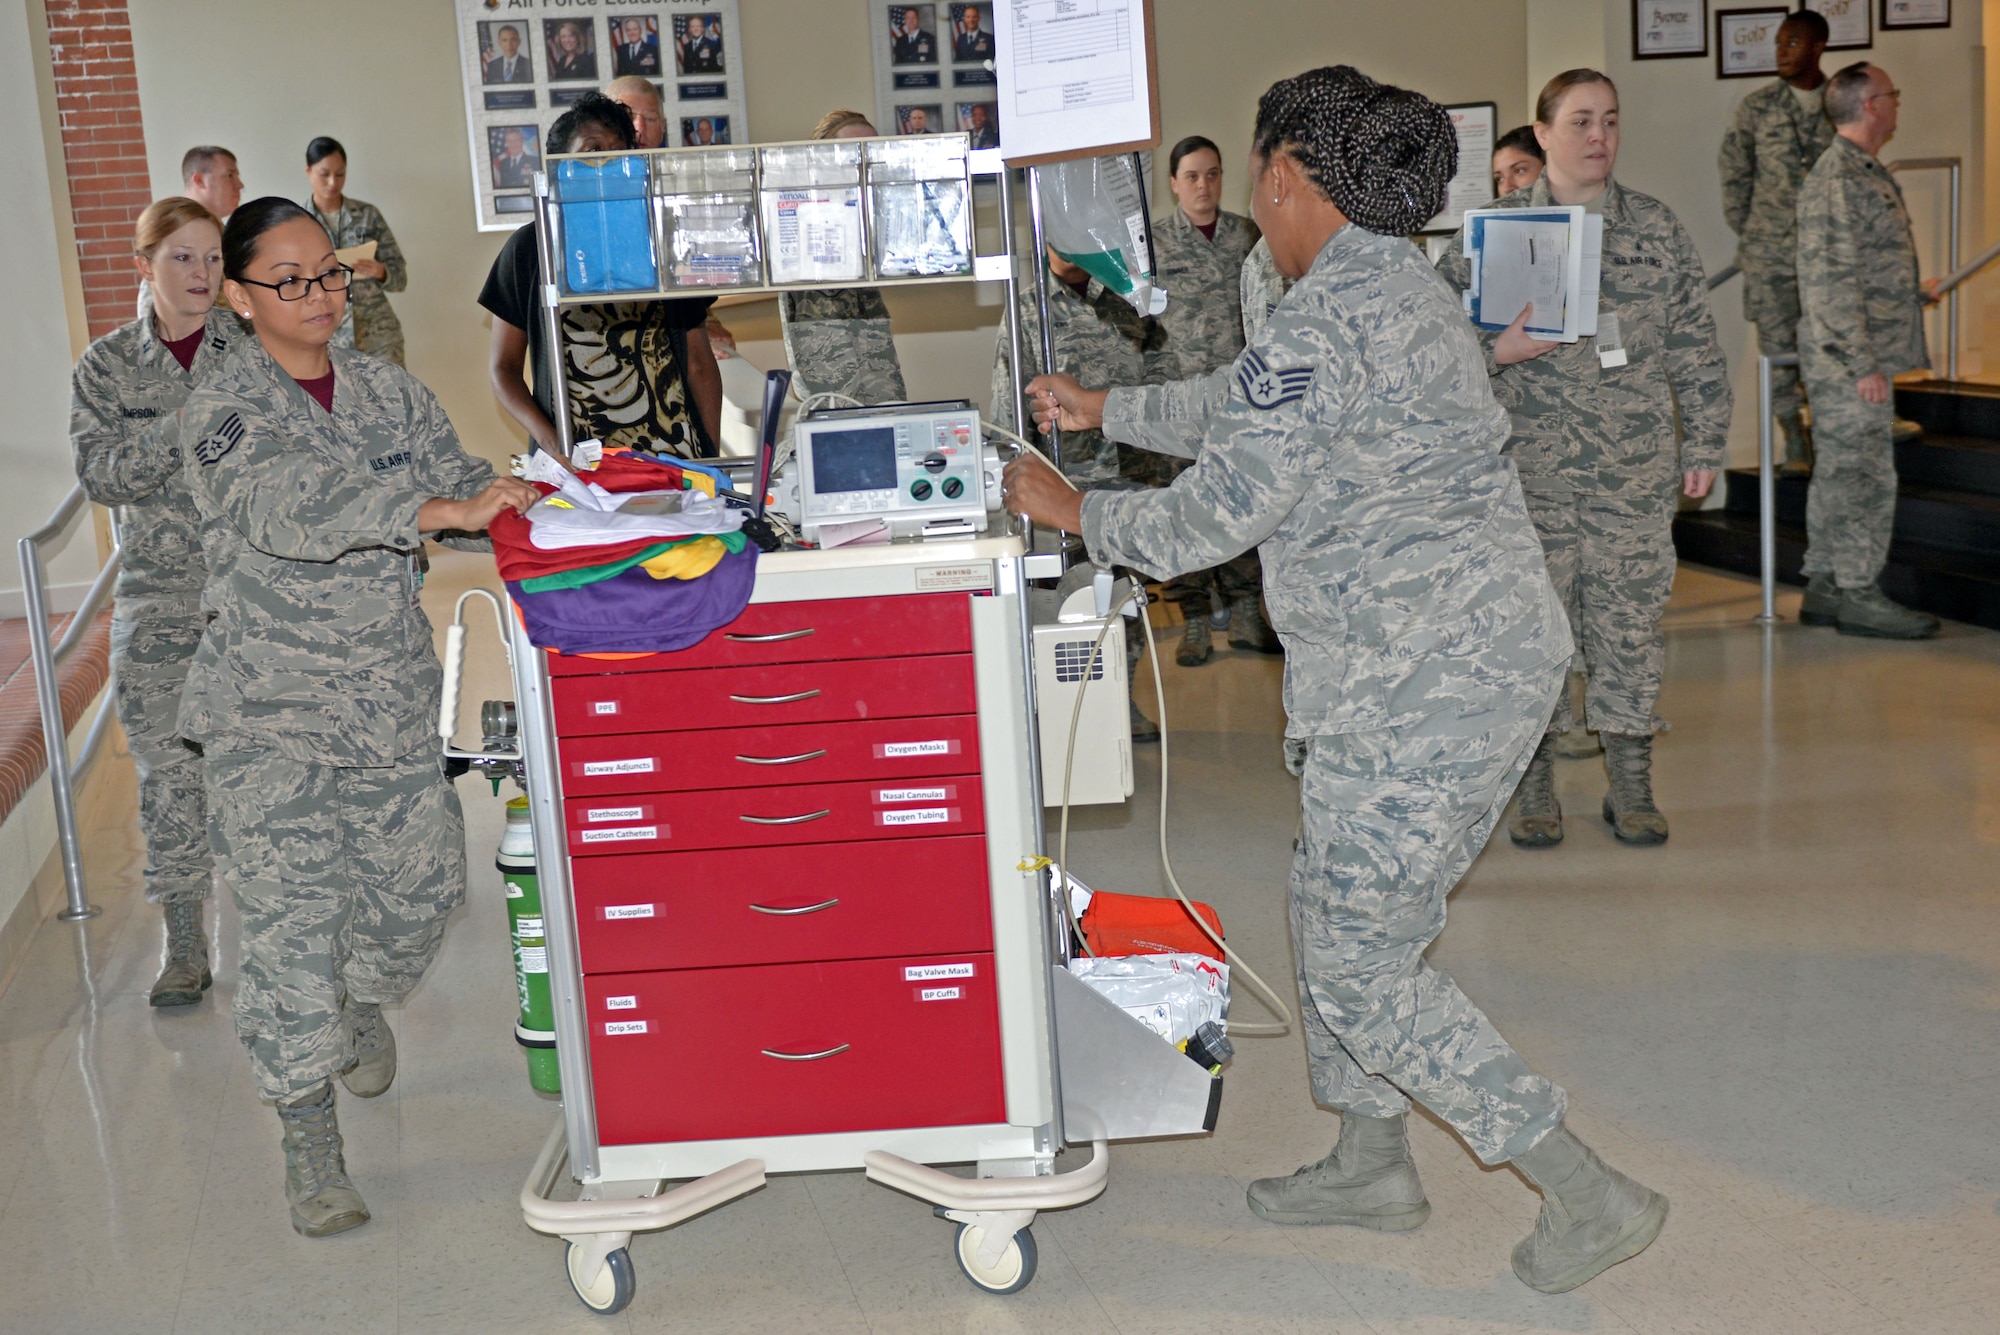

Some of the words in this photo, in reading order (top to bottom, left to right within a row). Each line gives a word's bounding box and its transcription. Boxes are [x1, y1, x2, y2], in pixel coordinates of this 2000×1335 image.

[1733, 23, 1774, 46] Gold
[369, 458, 389, 471] U.S.
[387, 453, 405, 468] AIR
[935, 568, 972, 576] WARNING
[598, 704, 614, 712] PPE
[887, 745, 918, 754] Oxygen
[919, 743, 946, 752] Masks
[585, 765, 614, 774] Airway
[615, 762, 651, 772] Adjuncts
[882, 792, 905, 800] Nasal
[906, 790, 944, 799] Cannulas
[589, 809, 639, 819] Stethoscope
[885, 814, 916, 823] Oxygen
[917, 811, 946, 820] Tubing
[584, 831, 614, 840] Suction
[615, 829, 655, 839] Catheters
[607, 910, 617, 918] IV
[617, 907, 652, 917] Supplies
[907, 969, 923, 978] Bag
[924, 967, 947, 976] Valve
[948, 966, 970, 975] Mask
[924, 991, 935, 999] BP
[936, 989, 957, 998] Cuffs
[608, 999, 633, 1007] Fluids
[608, 1025, 625, 1033] Drip
